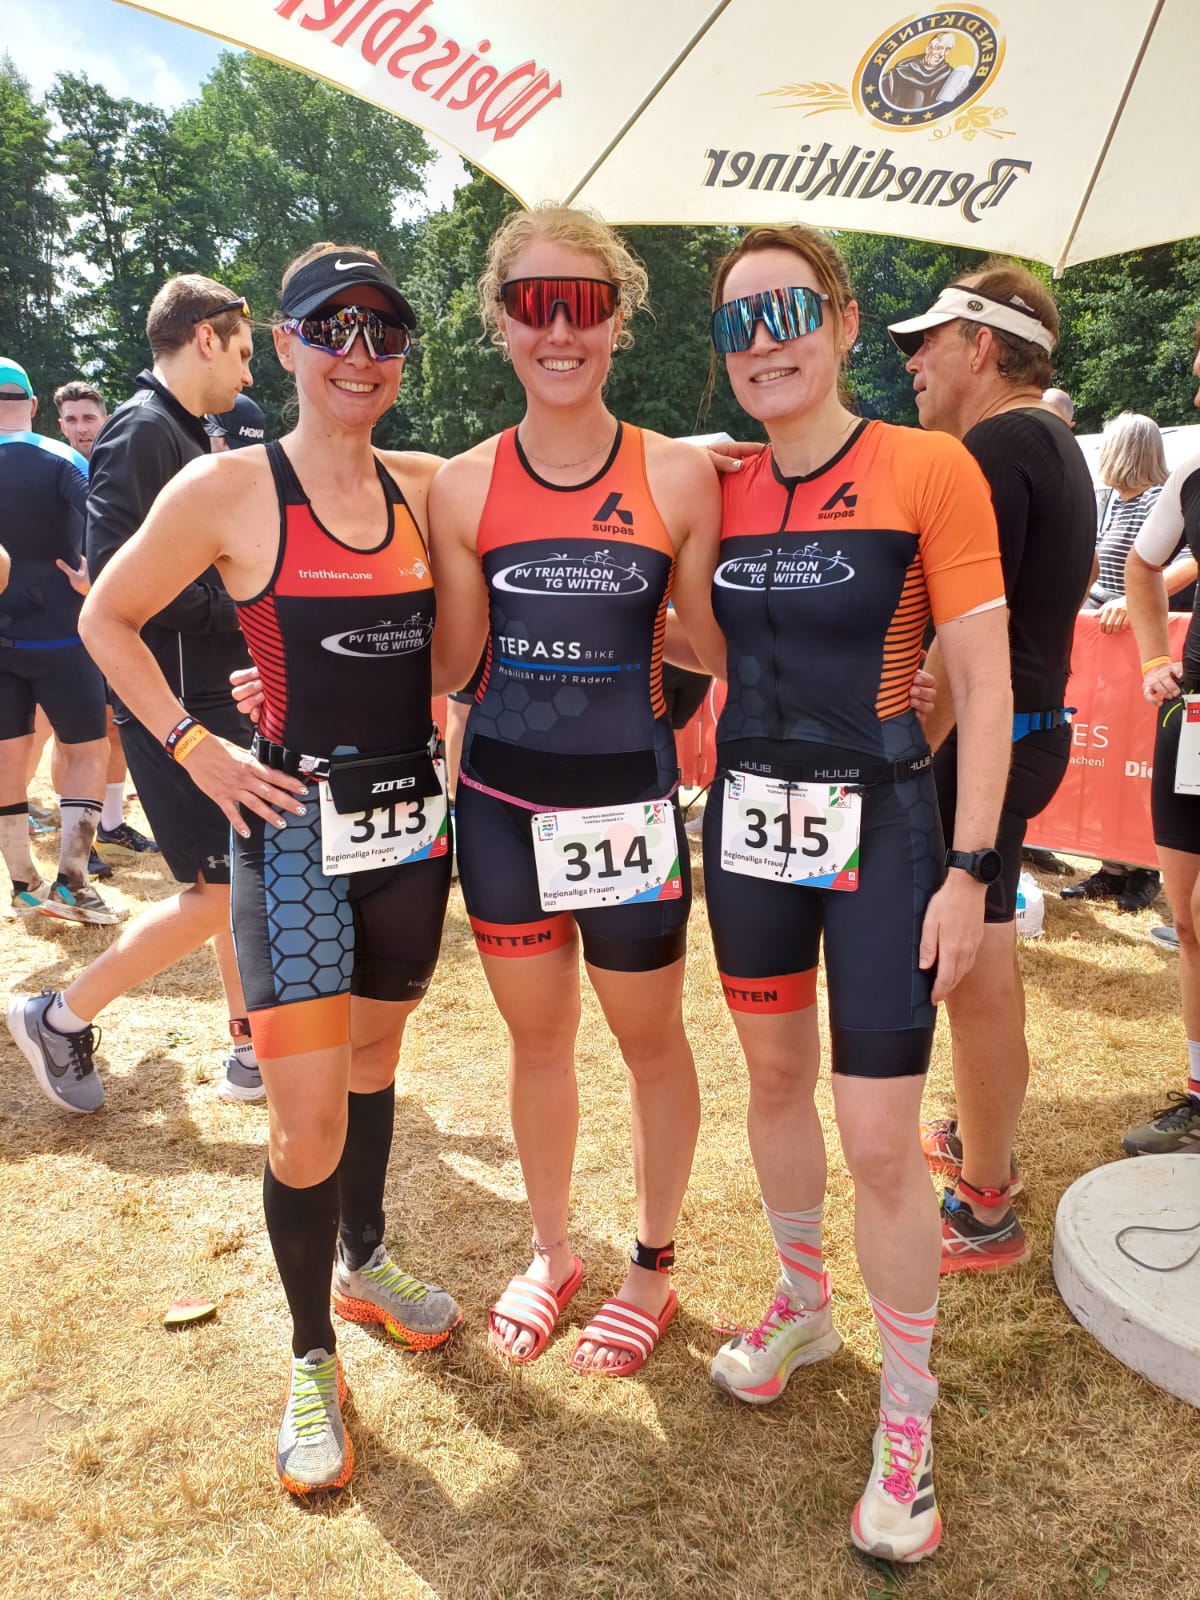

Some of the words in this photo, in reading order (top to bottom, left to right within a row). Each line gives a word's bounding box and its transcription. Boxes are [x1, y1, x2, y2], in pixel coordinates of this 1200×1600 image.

[817, 509, 855, 521] surpas
[592, 523, 635, 536] surpas
[298, 569, 373, 580] triathlon.one
[514, 569, 533, 580] PV
[535, 567, 614, 580] TRIATHLON
[726, 563, 742, 573] PV
[545, 578, 563, 589] TG
[567, 578, 621, 593] WITTEN
[750, 573, 765, 584] TG
[773, 573, 822, 584] WITTEN
[349, 634, 365, 644] PV
[366, 629, 423, 643] TRIATHLON
[375, 641, 389, 652] TG
[391, 637, 425, 650] WITTEN
[498, 636, 582, 660] TEPASS
[585, 650, 616, 660] BIKE
[539, 674, 556, 682] auf
[561, 674, 567, 683] 2
[1073, 723, 1109, 749] ES
[739, 761, 772, 773] HUUB
[814, 768, 860, 778] HUUB
[350, 798, 427, 843] 313
[744, 807, 829, 857] 315
[326, 850, 370, 862] Regionalliga
[371, 846, 395, 855] Frauen
[563, 835, 653, 882] 314
[723, 849, 762, 865] Regionalliga
[543, 889, 588, 899] Regionalliga
[589, 886, 615, 894] Frauen
[723, 984, 778, 1003] ITTEN
